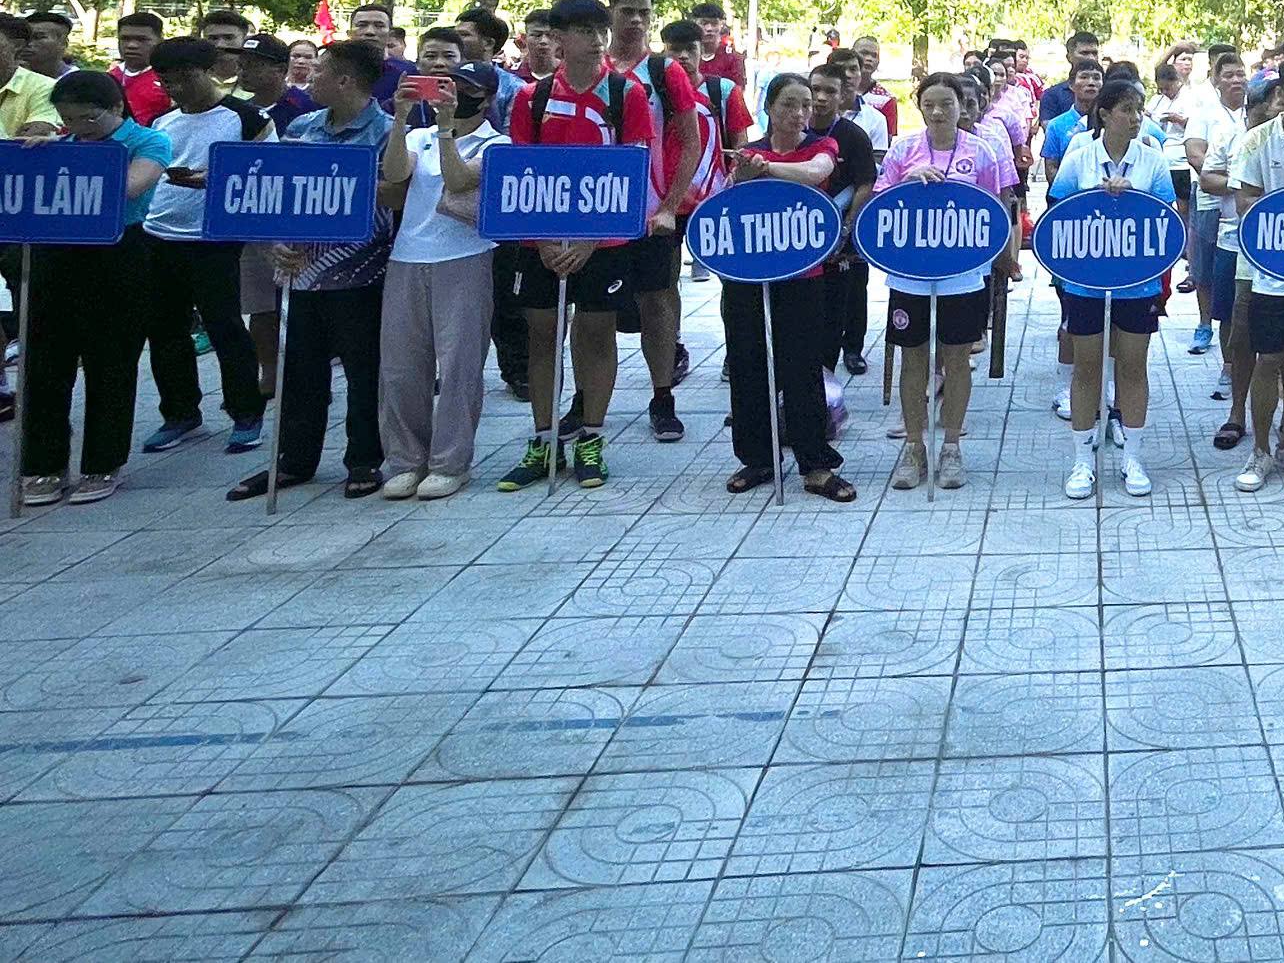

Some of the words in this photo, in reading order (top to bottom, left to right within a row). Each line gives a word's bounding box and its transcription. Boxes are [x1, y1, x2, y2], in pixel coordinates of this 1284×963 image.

[34, 166, 104, 215] LÂM
[224, 159, 283, 214] CẨM
[292, 163, 357, 216] THỦY
[501, 167, 570, 214] ĐÔNG
[577, 174, 630, 214] SƠN
[700, 208, 735, 257] BÁ
[741, 200, 825, 254] THƯỚC
[877, 200, 909, 248] PÙ
[915, 200, 990, 248] LUÔNG
[1052, 209, 1136, 259] MƯỜNG
[1143, 208, 1169, 256] LÝ
